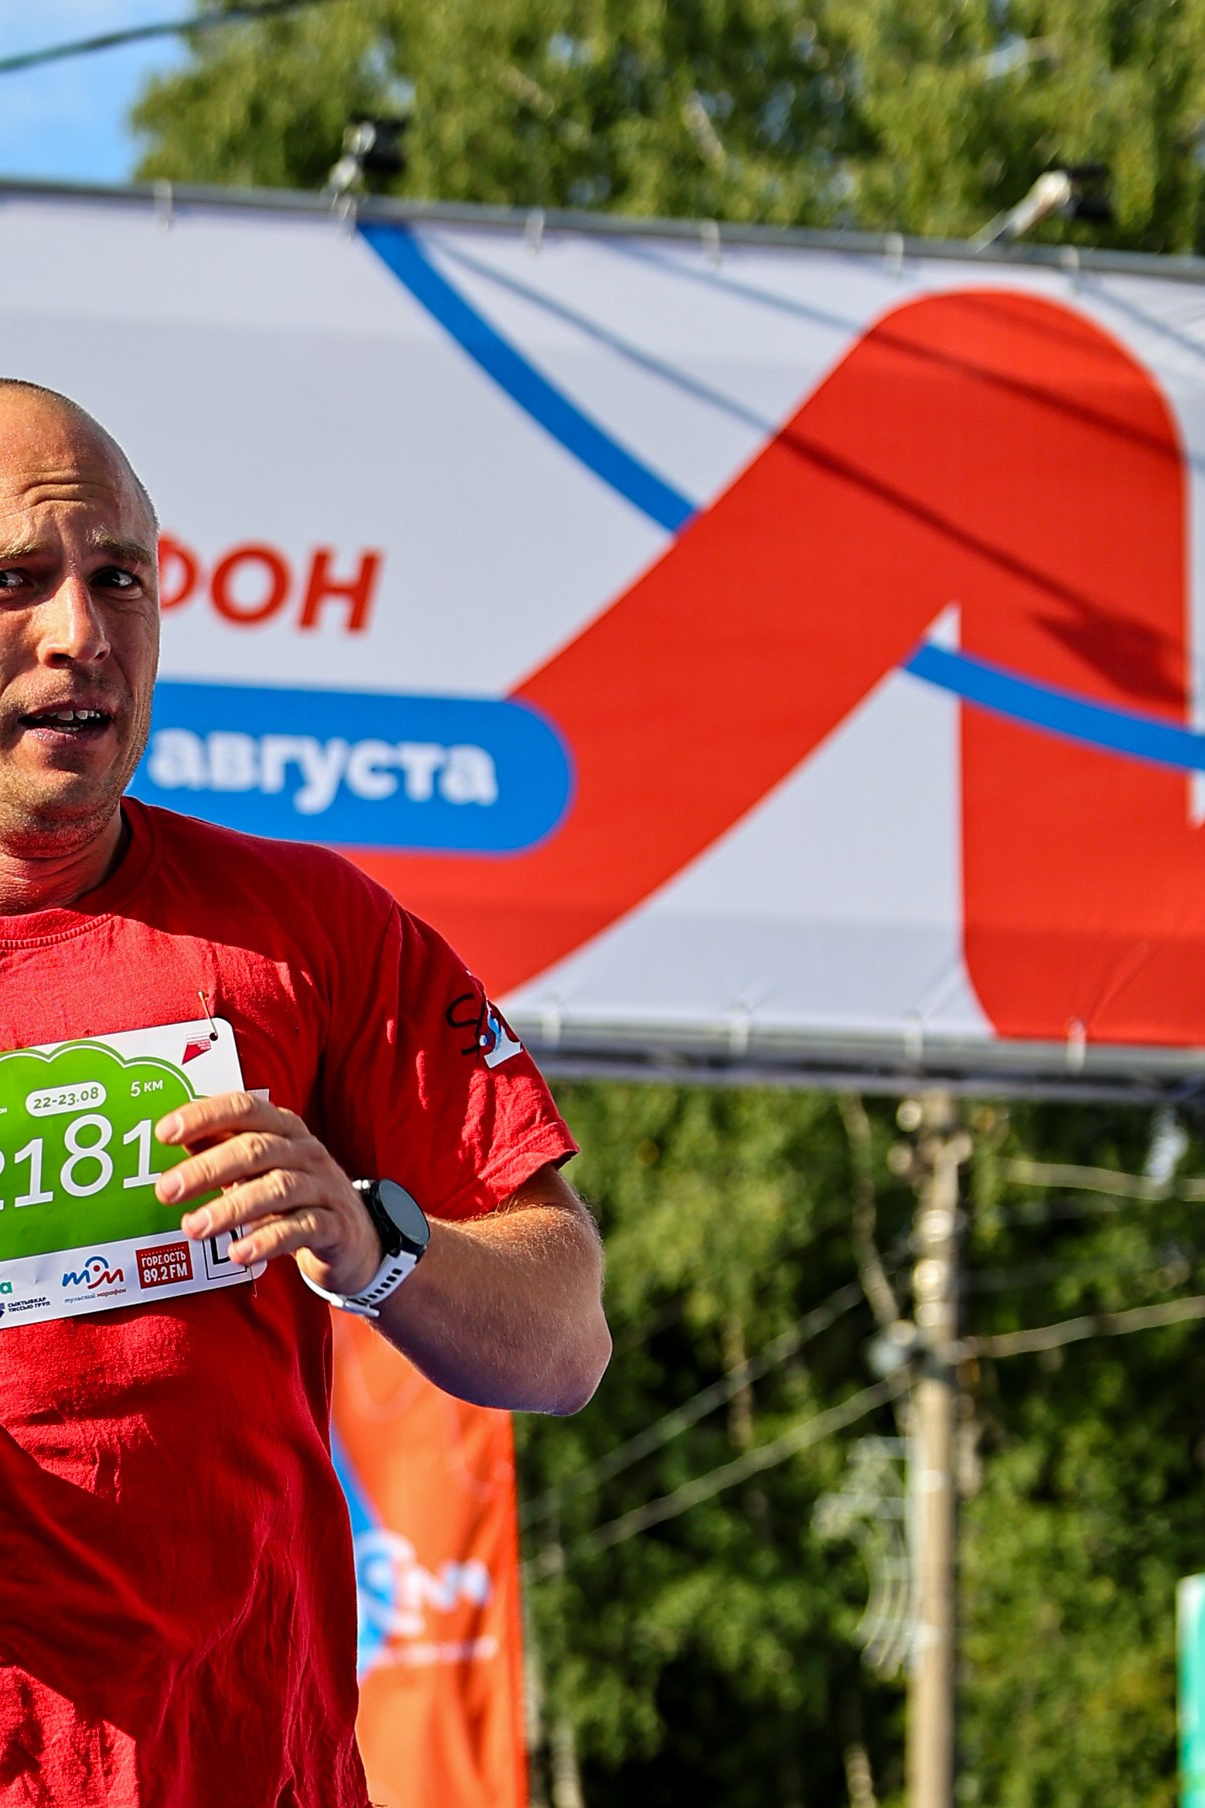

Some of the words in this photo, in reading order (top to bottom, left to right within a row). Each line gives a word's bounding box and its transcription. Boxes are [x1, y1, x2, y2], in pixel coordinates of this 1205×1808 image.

[147, 727, 498, 814] августа
[34, 1086, 99, 1110] 22-23.08
[130, 1081, 141, 1097] 5
[143, 1266, 169, 1283] 89.2
[169, 1262, 188, 1280] FM
